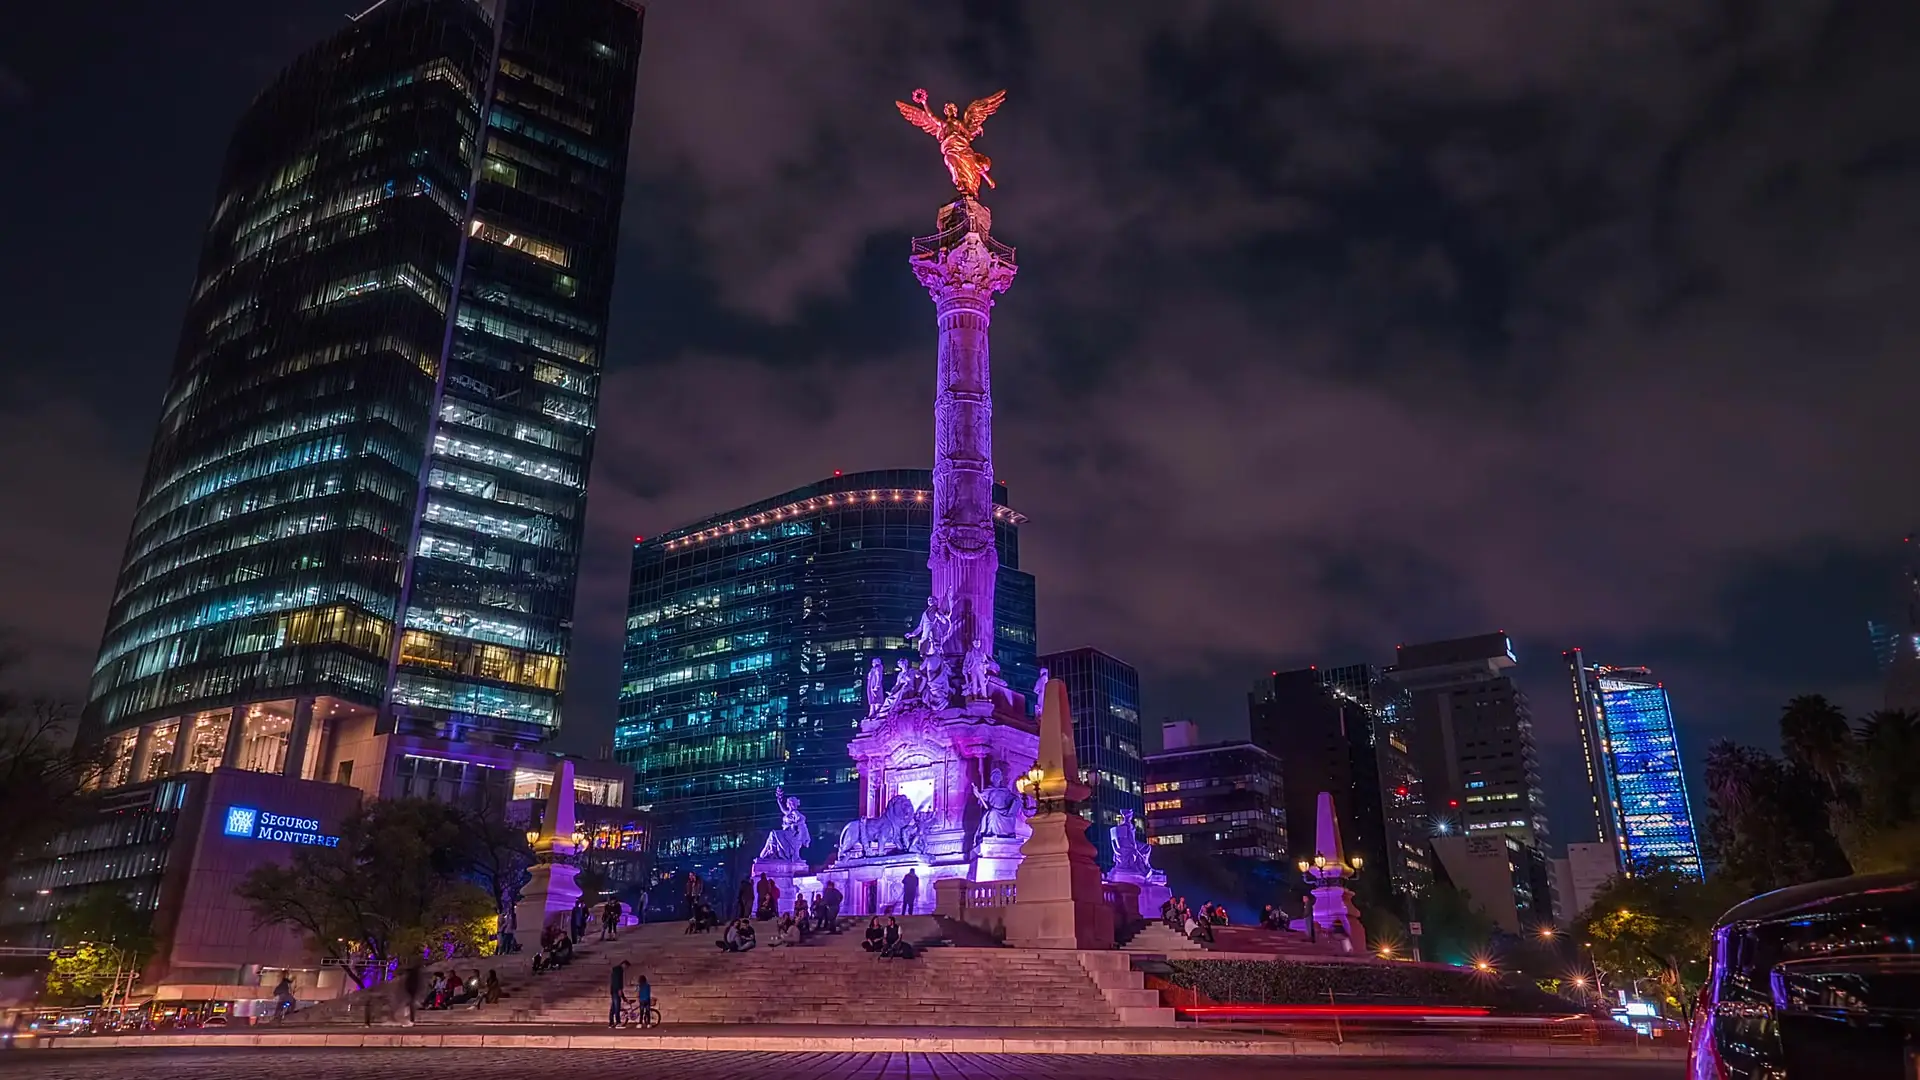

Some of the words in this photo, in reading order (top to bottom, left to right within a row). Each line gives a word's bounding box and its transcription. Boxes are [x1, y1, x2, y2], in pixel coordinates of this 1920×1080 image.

[229, 815, 253, 827] YORK
[232, 810, 253, 820] NEW
[261, 812, 319, 831] SEGUROS
[229, 823, 249, 833] LIFE
[258, 827, 340, 848] MONTERREY
